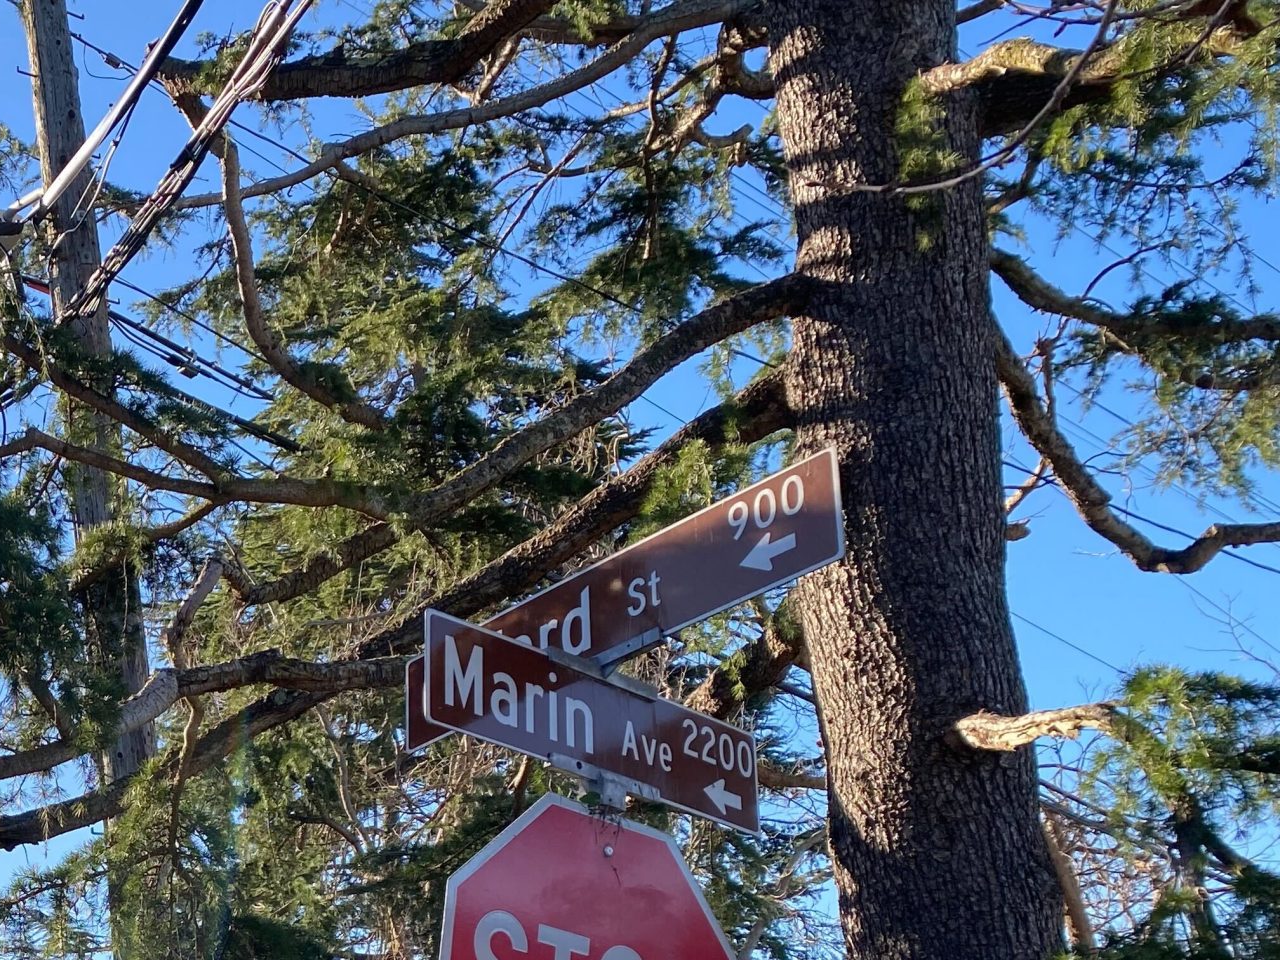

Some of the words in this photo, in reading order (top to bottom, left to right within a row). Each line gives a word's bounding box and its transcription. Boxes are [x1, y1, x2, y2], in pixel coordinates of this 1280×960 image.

[627, 570, 662, 617] St
[727, 474, 805, 540] 900
[444, 635, 594, 754] Marin
[622, 721, 673, 773] Ave
[683, 718, 753, 778] 2200
